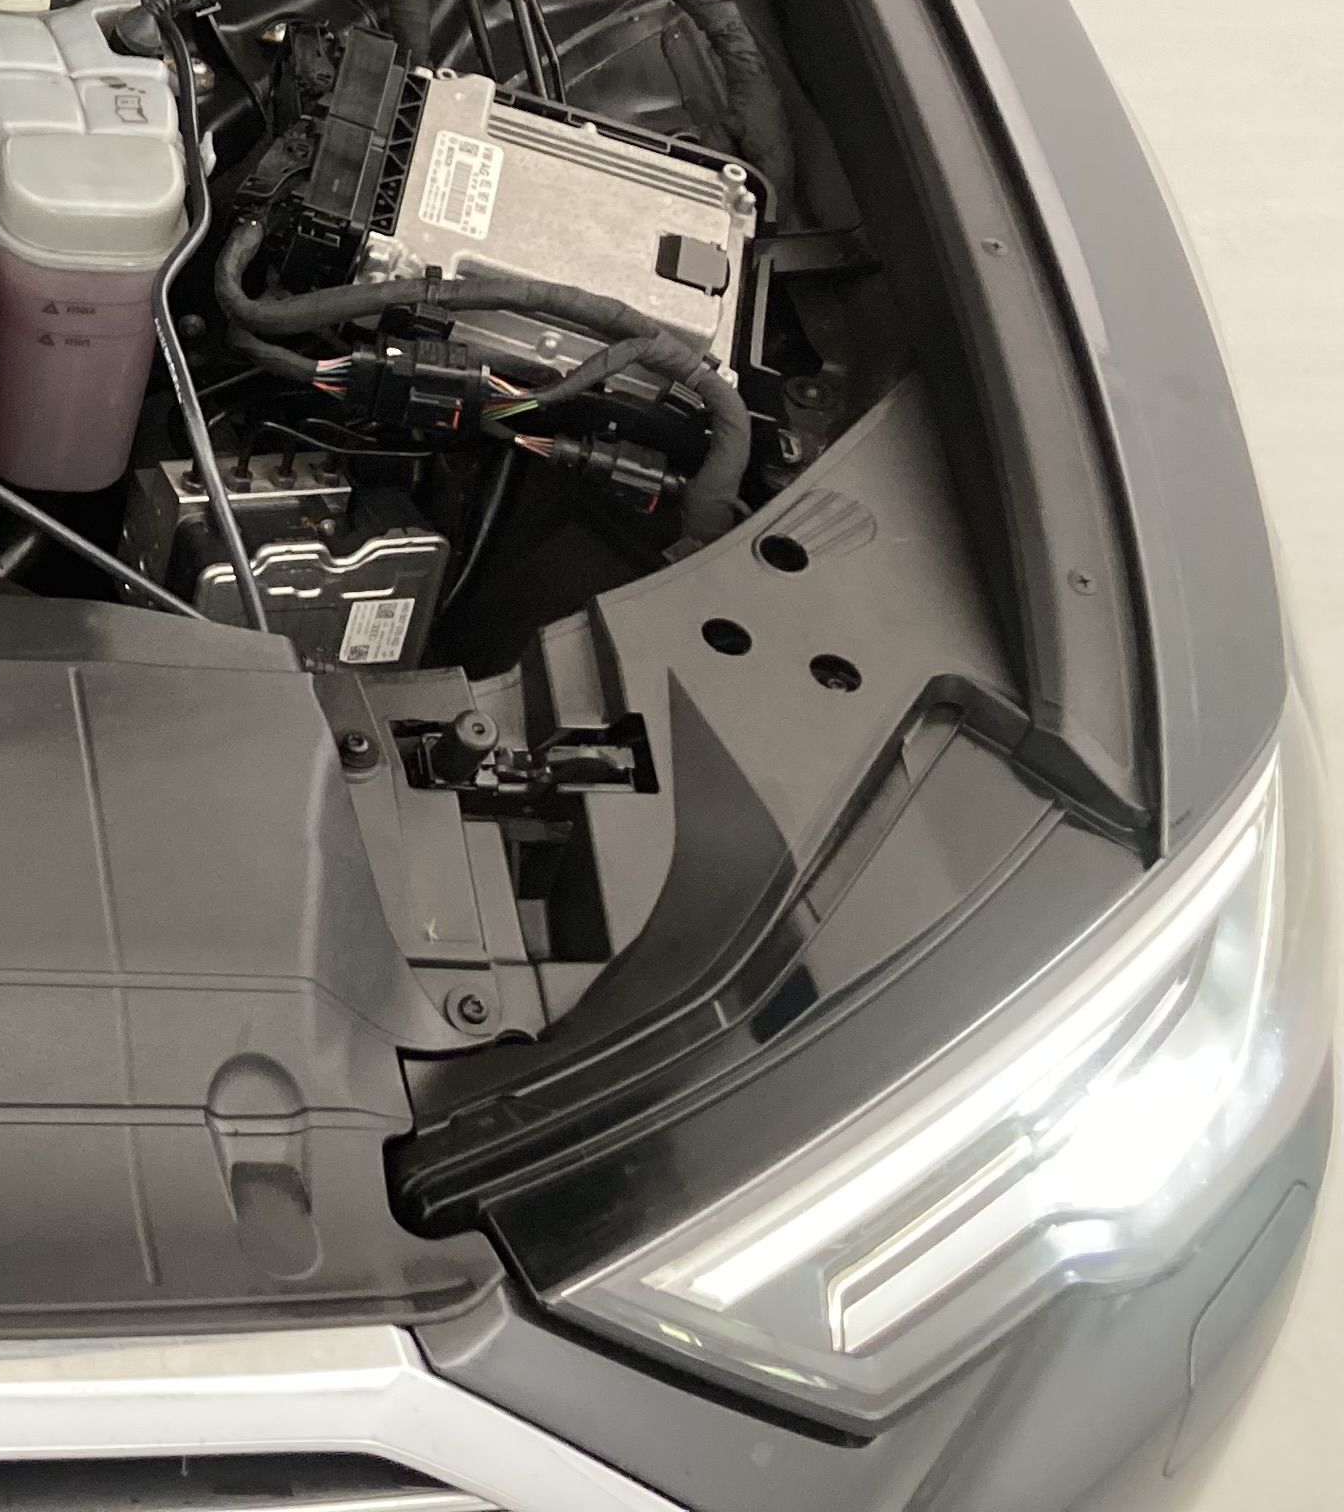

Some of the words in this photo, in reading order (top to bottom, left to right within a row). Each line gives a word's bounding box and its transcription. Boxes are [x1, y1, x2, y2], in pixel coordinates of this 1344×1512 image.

[479, 162, 491, 177] AG
[66, 307, 96, 315] max
[64, 338, 90, 347] min
